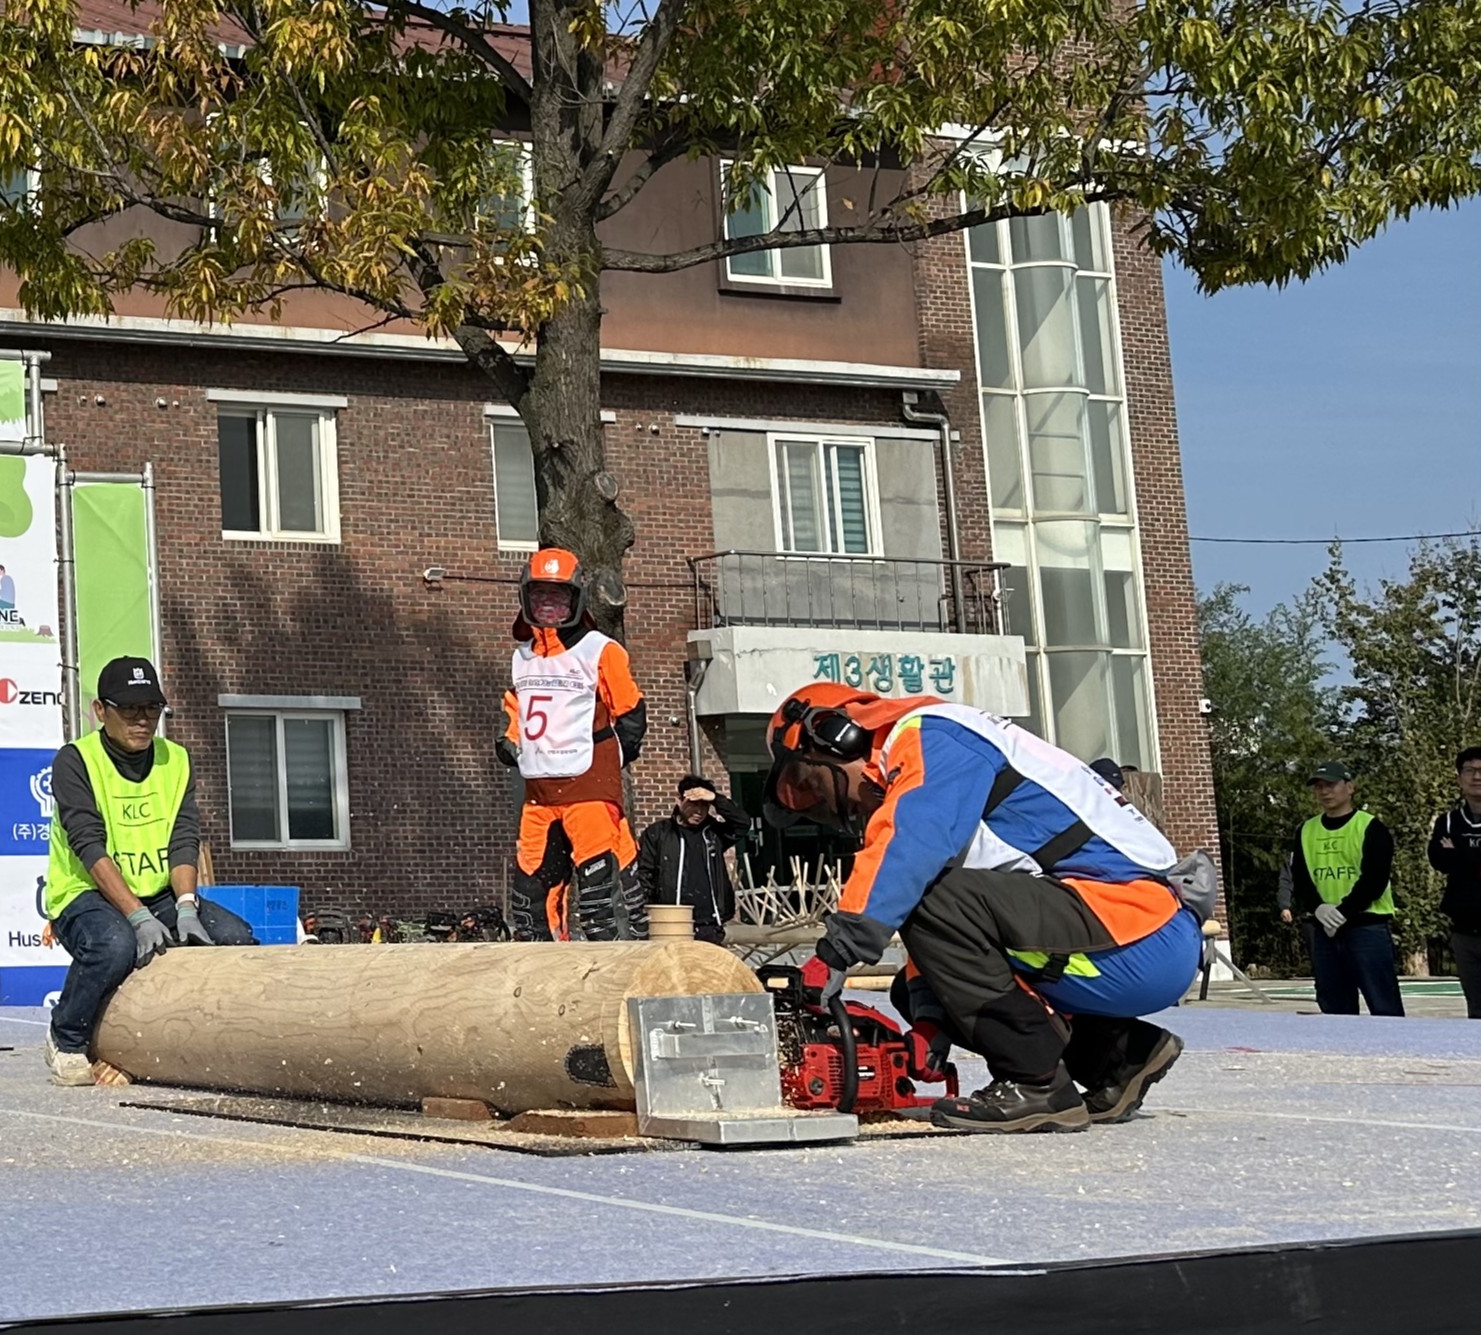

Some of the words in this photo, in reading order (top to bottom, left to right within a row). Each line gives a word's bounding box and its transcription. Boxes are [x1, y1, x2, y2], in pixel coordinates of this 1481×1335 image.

[813, 653, 956, 694] 제3생활관
[524, 695, 553, 741] 5
[121, 802, 151, 821] KLC
